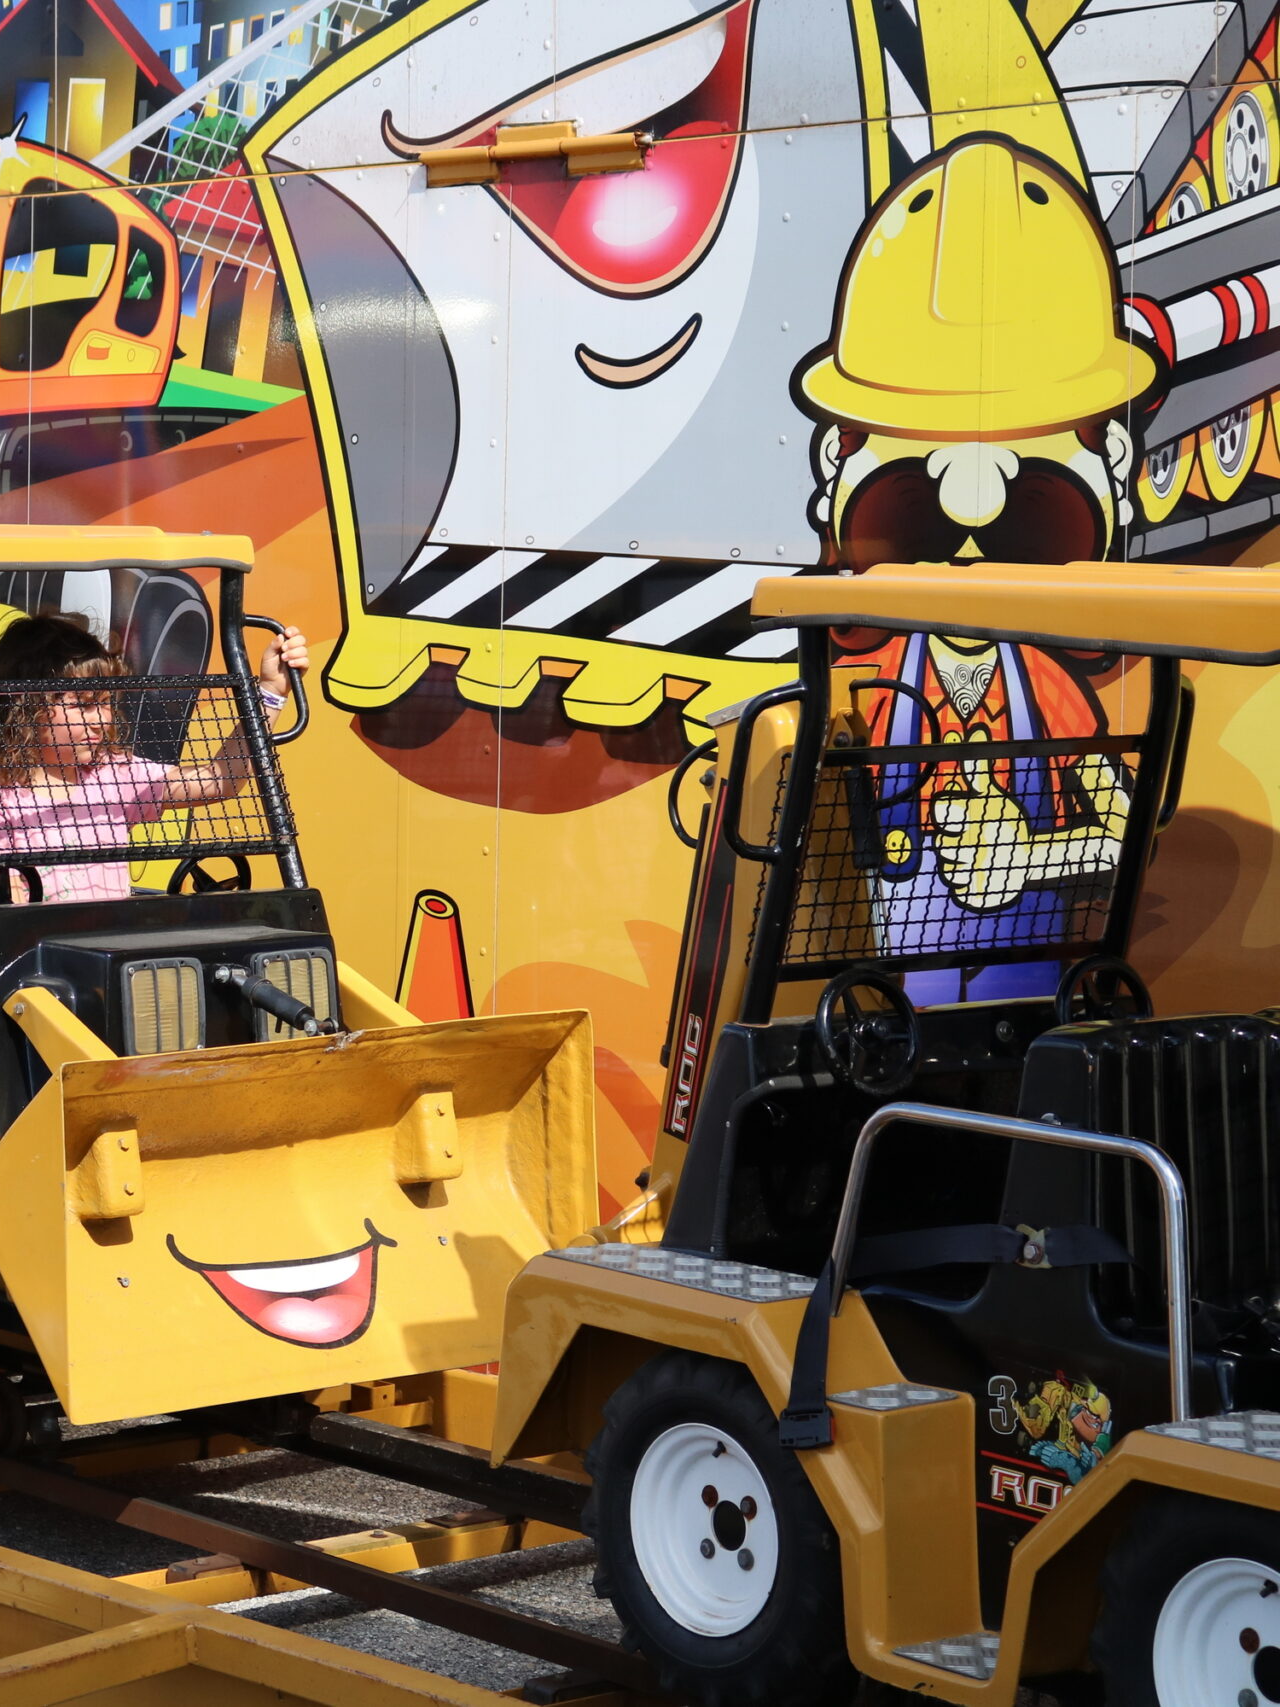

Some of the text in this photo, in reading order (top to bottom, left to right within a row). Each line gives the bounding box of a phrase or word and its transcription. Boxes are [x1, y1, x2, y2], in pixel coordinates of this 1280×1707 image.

[671, 1013, 702, 1134] ROC
[987, 1375, 1019, 1435] 3
[989, 1465, 1074, 1514] RO
